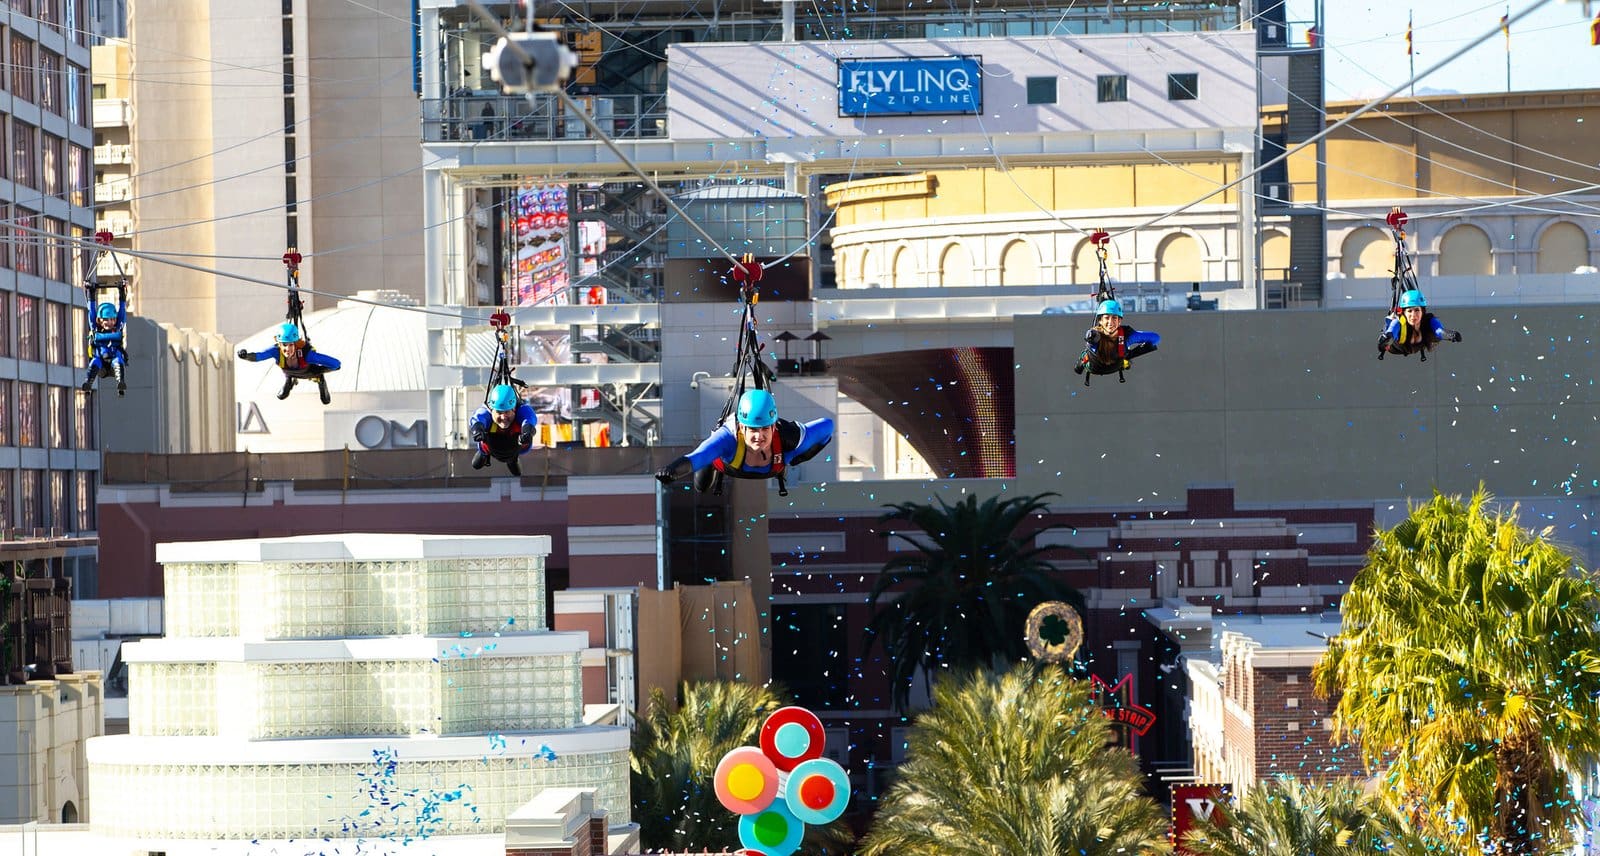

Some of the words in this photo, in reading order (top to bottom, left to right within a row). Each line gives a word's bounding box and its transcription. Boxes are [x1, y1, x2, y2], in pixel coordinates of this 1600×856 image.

[850, 68, 970, 93] FLYLINQ
[888, 94, 970, 105] ZIPLINE
[1119, 708, 1147, 727] STRIP
